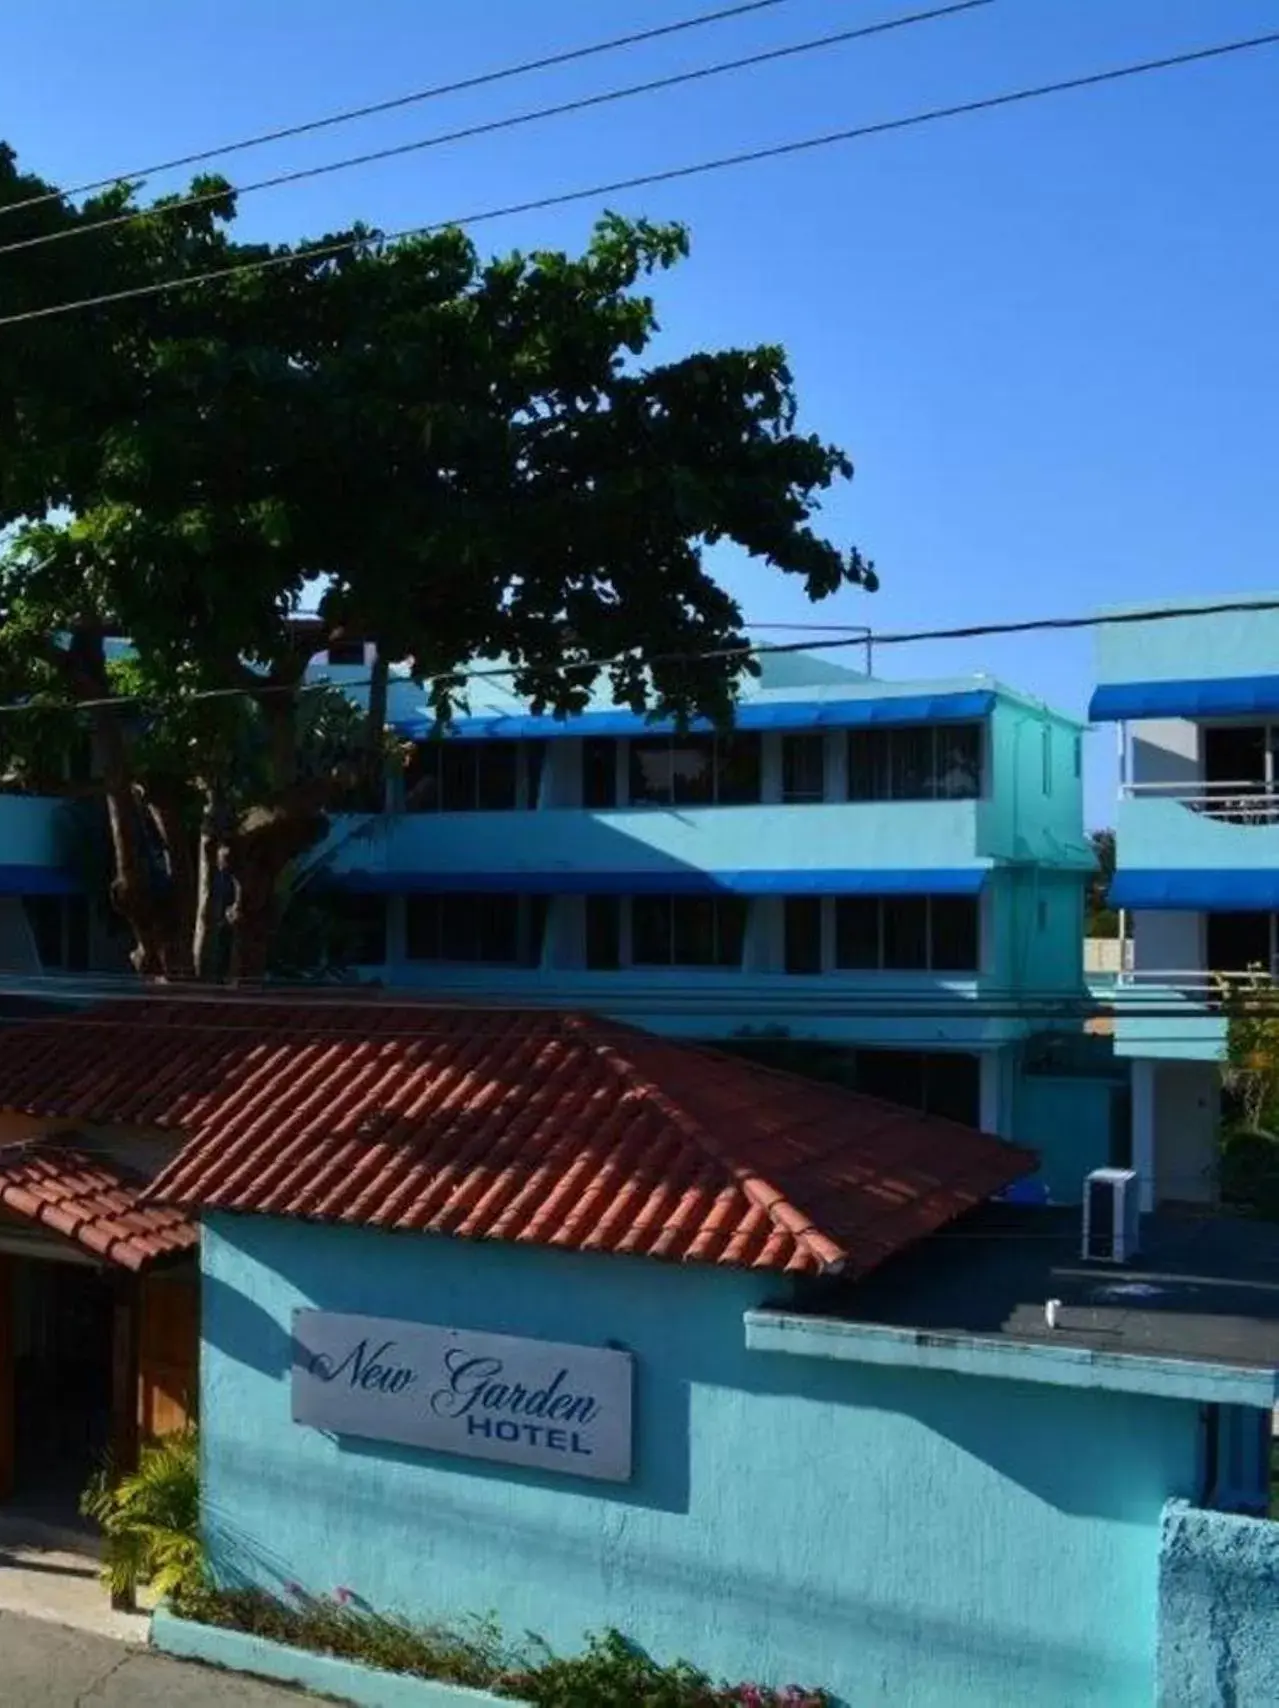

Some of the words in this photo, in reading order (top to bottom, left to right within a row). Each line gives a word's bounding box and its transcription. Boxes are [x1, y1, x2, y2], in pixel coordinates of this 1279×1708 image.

[308, 1339, 418, 1393] New
[431, 1348, 601, 1425] Garden
[467, 1415, 592, 1455] HOTEL
